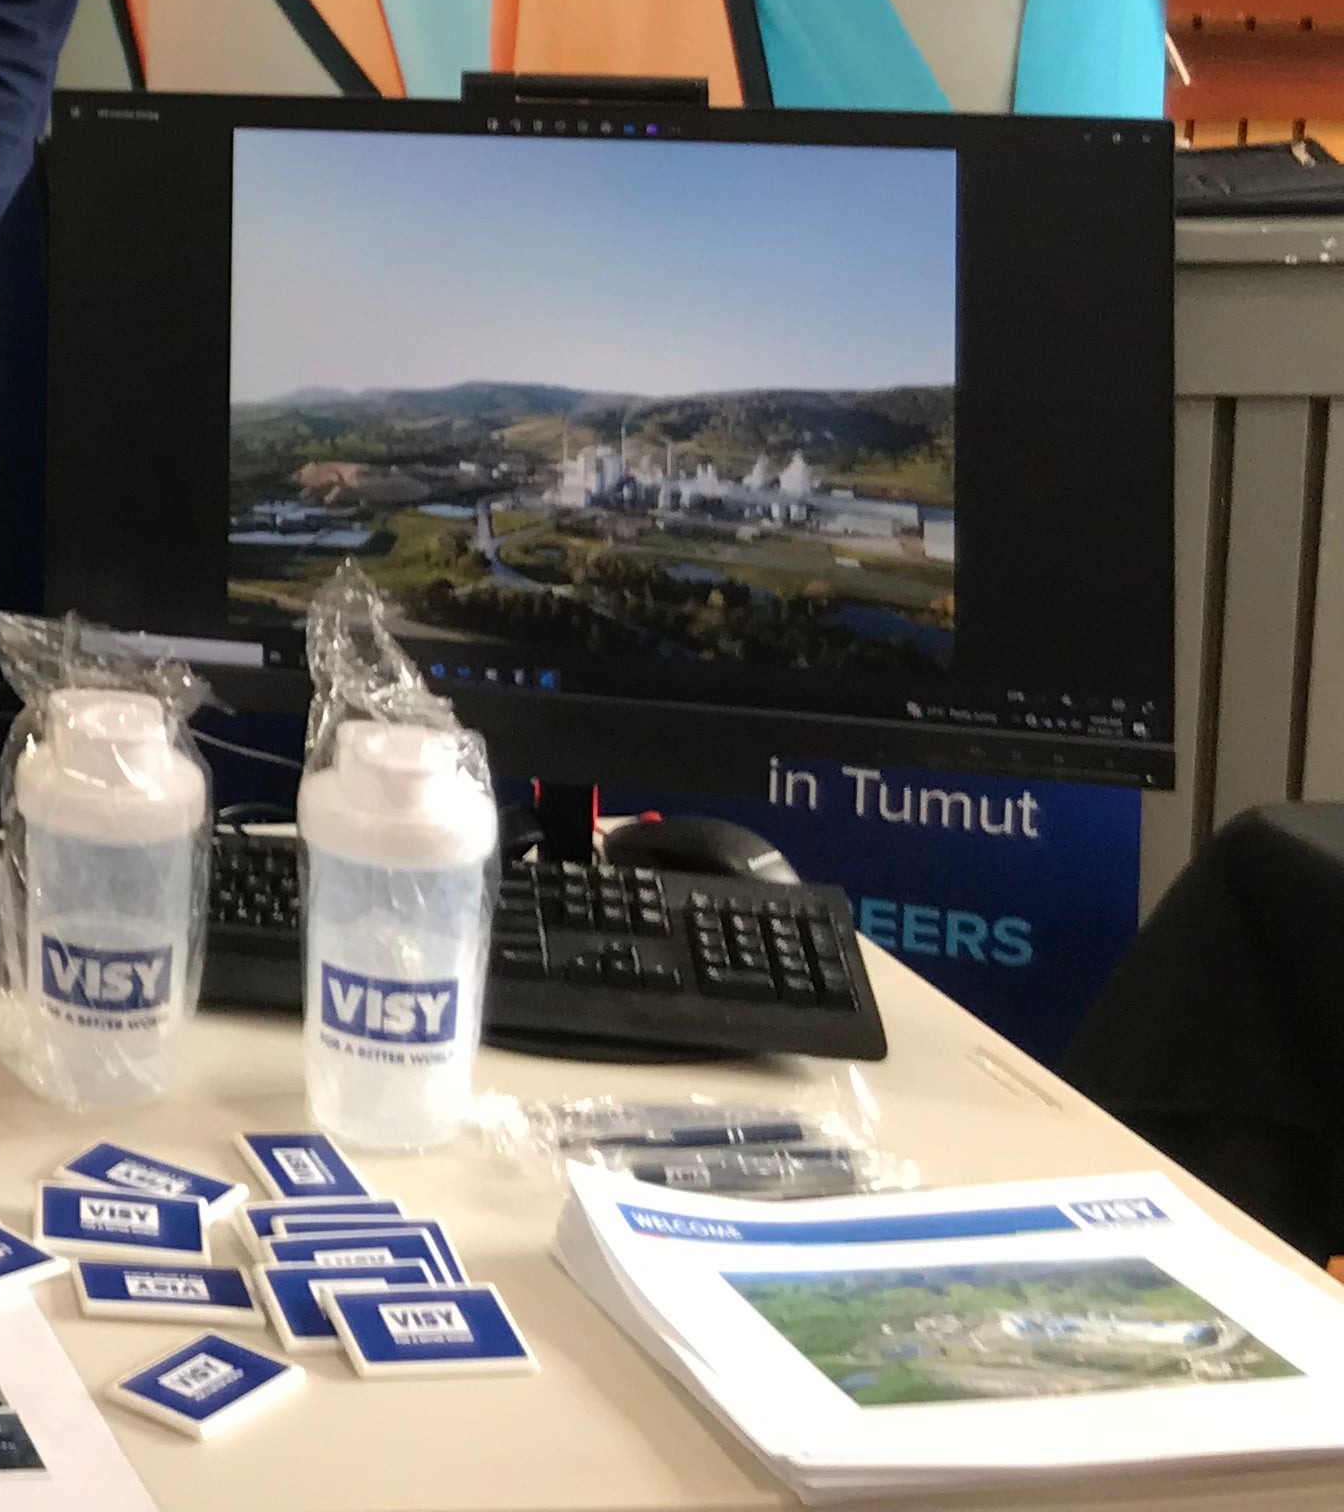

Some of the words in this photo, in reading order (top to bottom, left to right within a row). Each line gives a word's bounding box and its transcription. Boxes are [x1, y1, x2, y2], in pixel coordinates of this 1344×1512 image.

[769, 755, 817, 810] in
[841, 764, 1040, 839] Tumut
[852, 896, 1035, 968] EERS
[47, 946, 163, 1001] VISY
[328, 977, 451, 1035] VISY
[358, 1045, 405, 1064] BETTER
[87, 1205, 152, 1222] VISY
[1077, 1200, 1154, 1222] VISY
[388, 1310, 454, 1329] VISY
